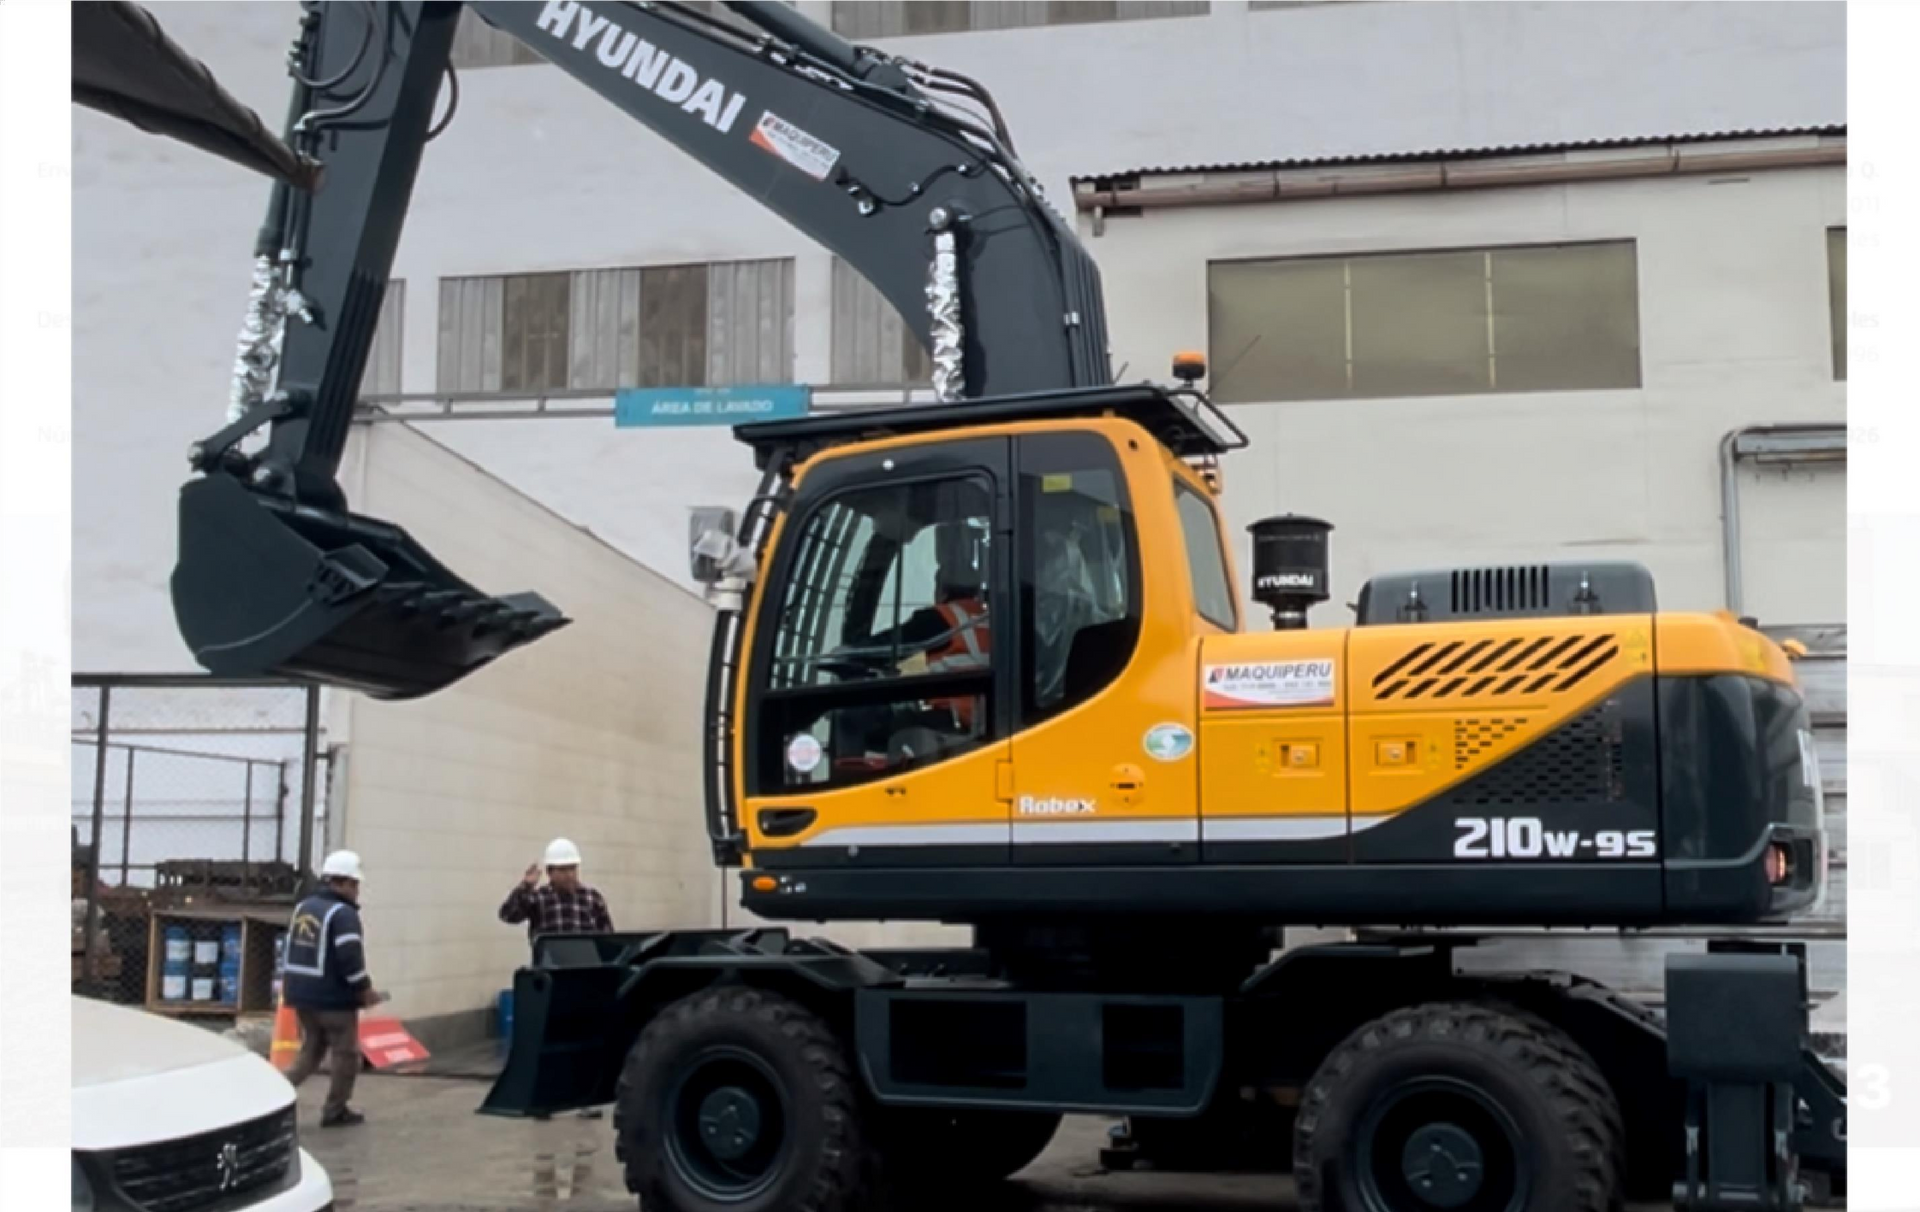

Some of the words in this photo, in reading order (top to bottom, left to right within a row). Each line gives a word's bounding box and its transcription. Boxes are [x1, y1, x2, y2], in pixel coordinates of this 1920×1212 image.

[535, 0, 748, 134] HYUNDAI
[651, 398, 690, 414] ÁREA
[693, 400, 712, 414] DE
[716, 399, 774, 413] LAVADO
[1225, 662, 1332, 680] MAQUIPERU
